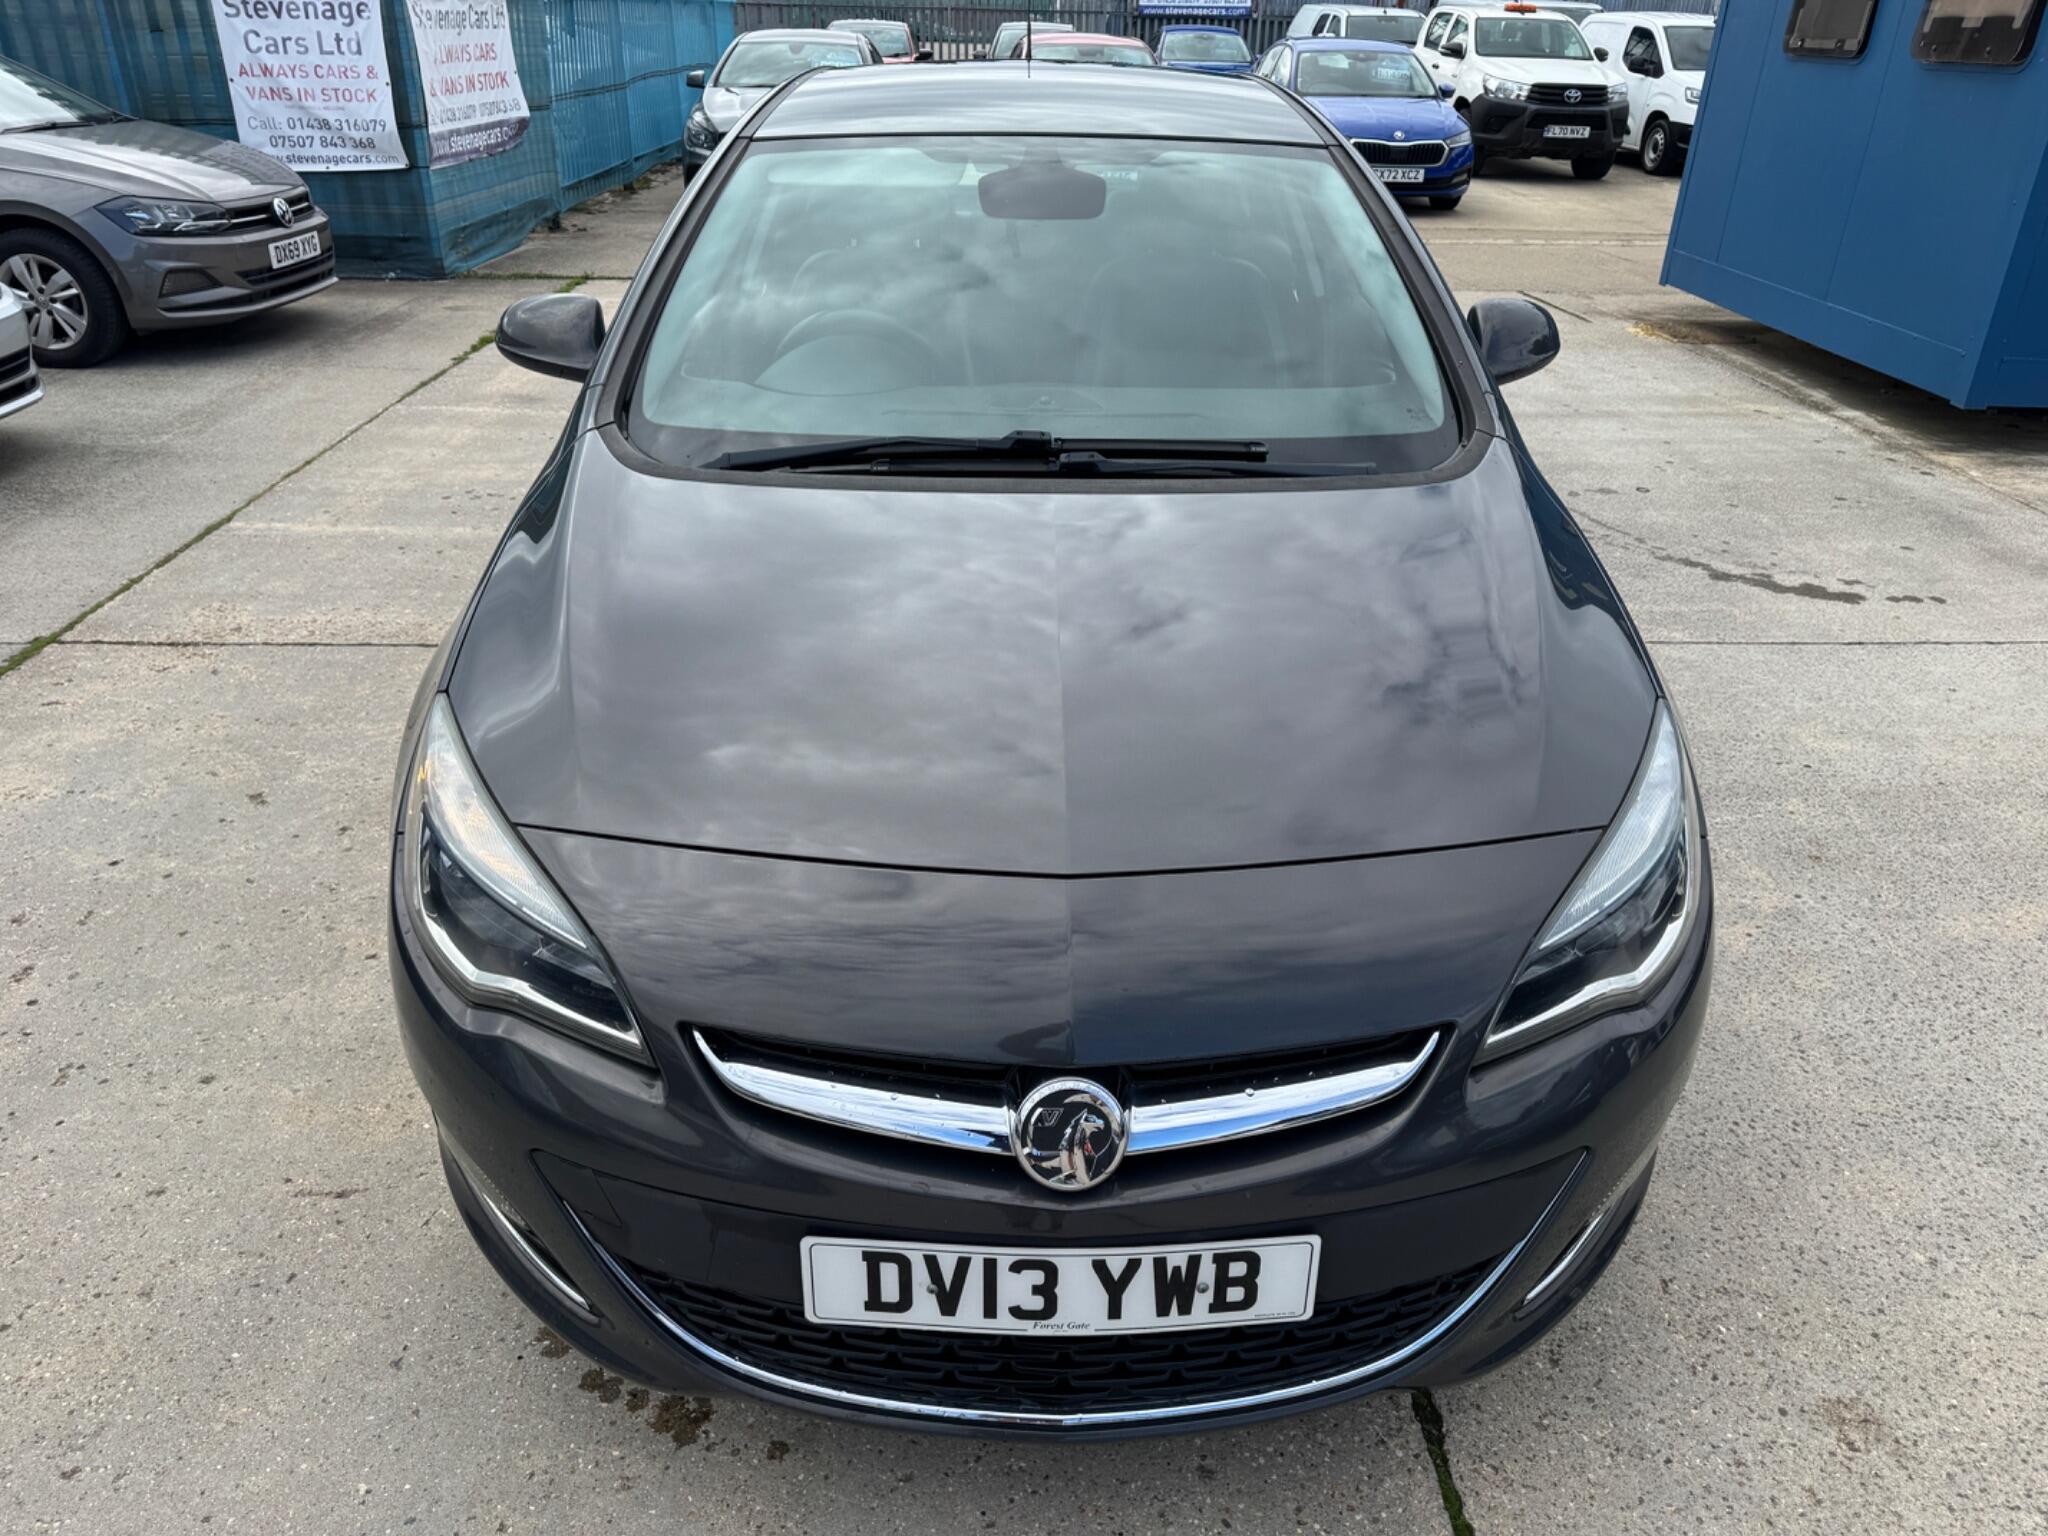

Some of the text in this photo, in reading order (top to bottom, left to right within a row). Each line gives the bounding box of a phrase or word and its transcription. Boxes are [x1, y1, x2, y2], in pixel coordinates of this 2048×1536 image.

[222, 0, 371, 27] Stevenage
[469, 4, 490, 29] Cars
[243, 29, 362, 56] Cars Ltd
[473, 42, 497, 61] CARS
[238, 63, 379, 80] ALWAYS CARS &
[464, 73, 476, 92] IN
[245, 86, 377, 102] VANS IN STOCK
[247, 116, 387, 132] Call: 01438 316079
[269, 135, 376, 149] 07507 843 368
[271, 153, 399, 166] w.stevenagecars.com
[1400, 169, 1420, 180] XCZ
[274, 234, 318, 264] DX69 XYG
[861, 1249, 1261, 1320] DV13 YWB
[1033, 1321, 1091, 1330] Forest Gate
